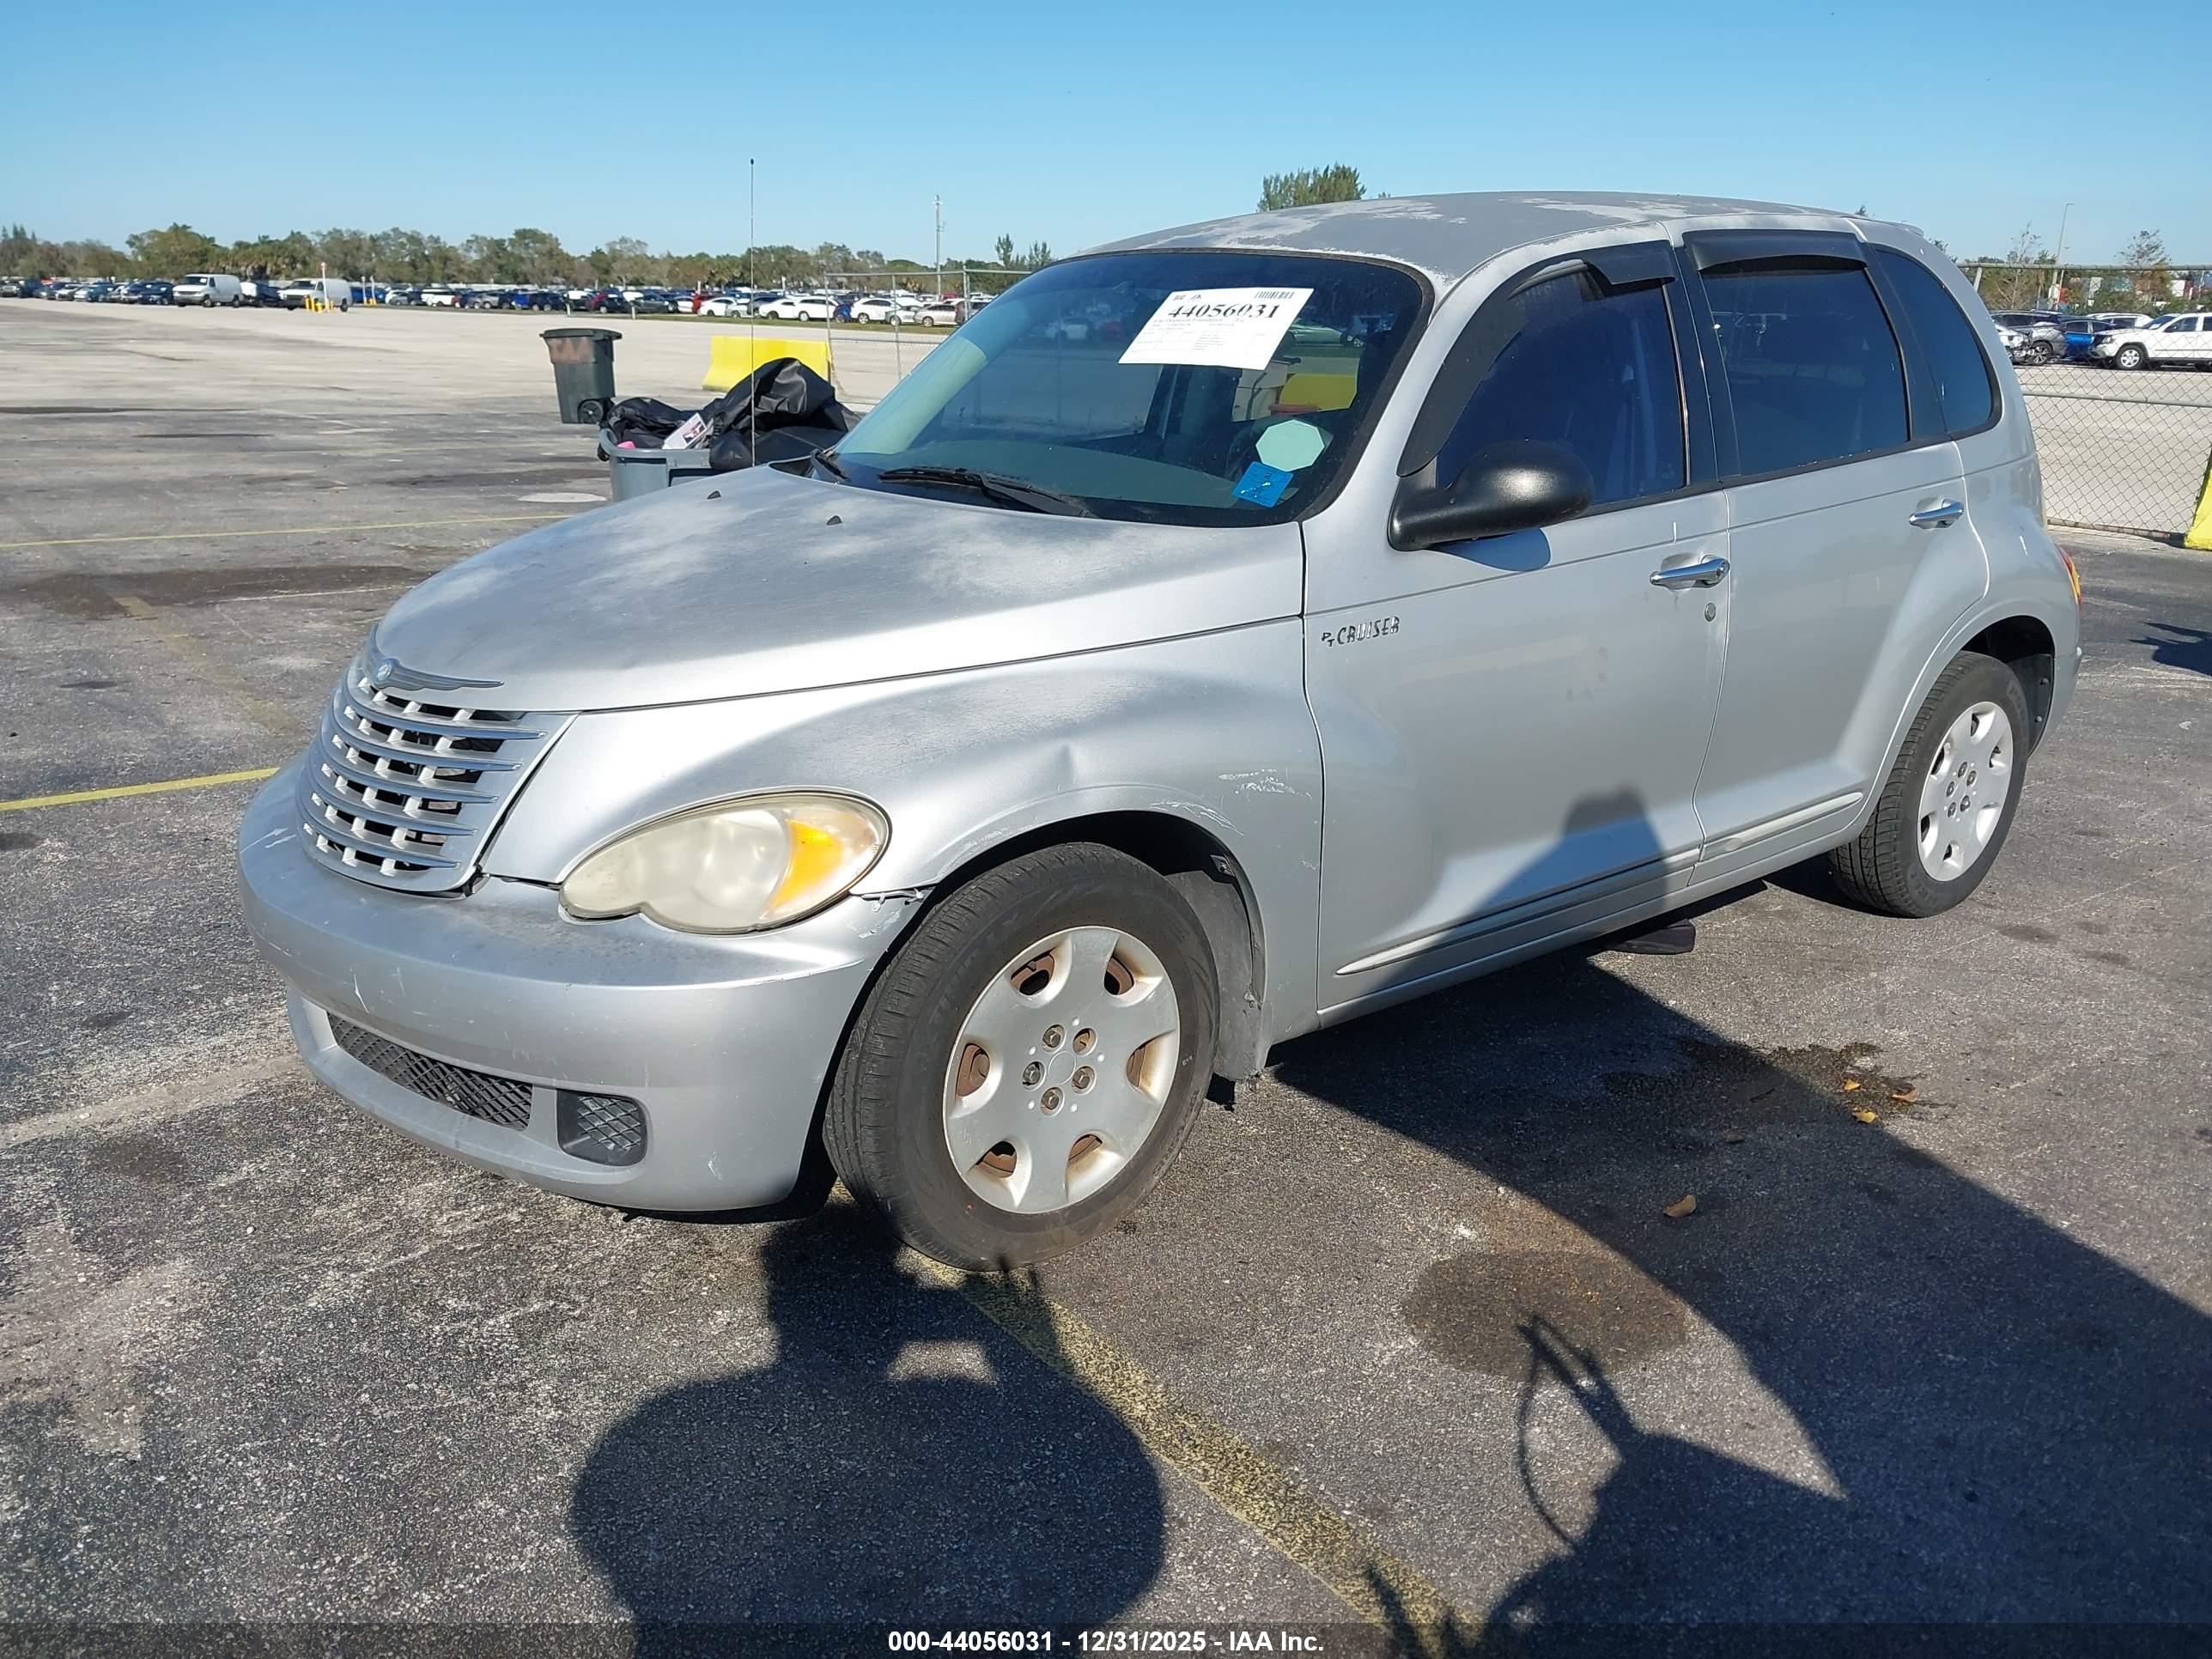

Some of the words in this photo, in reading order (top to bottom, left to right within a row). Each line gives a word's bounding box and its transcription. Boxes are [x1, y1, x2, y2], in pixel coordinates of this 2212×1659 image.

[1168, 303, 1280, 319] 44056031
[1321, 632, 1335, 647] PT
[1337, 616, 1400, 645] CRUISER
